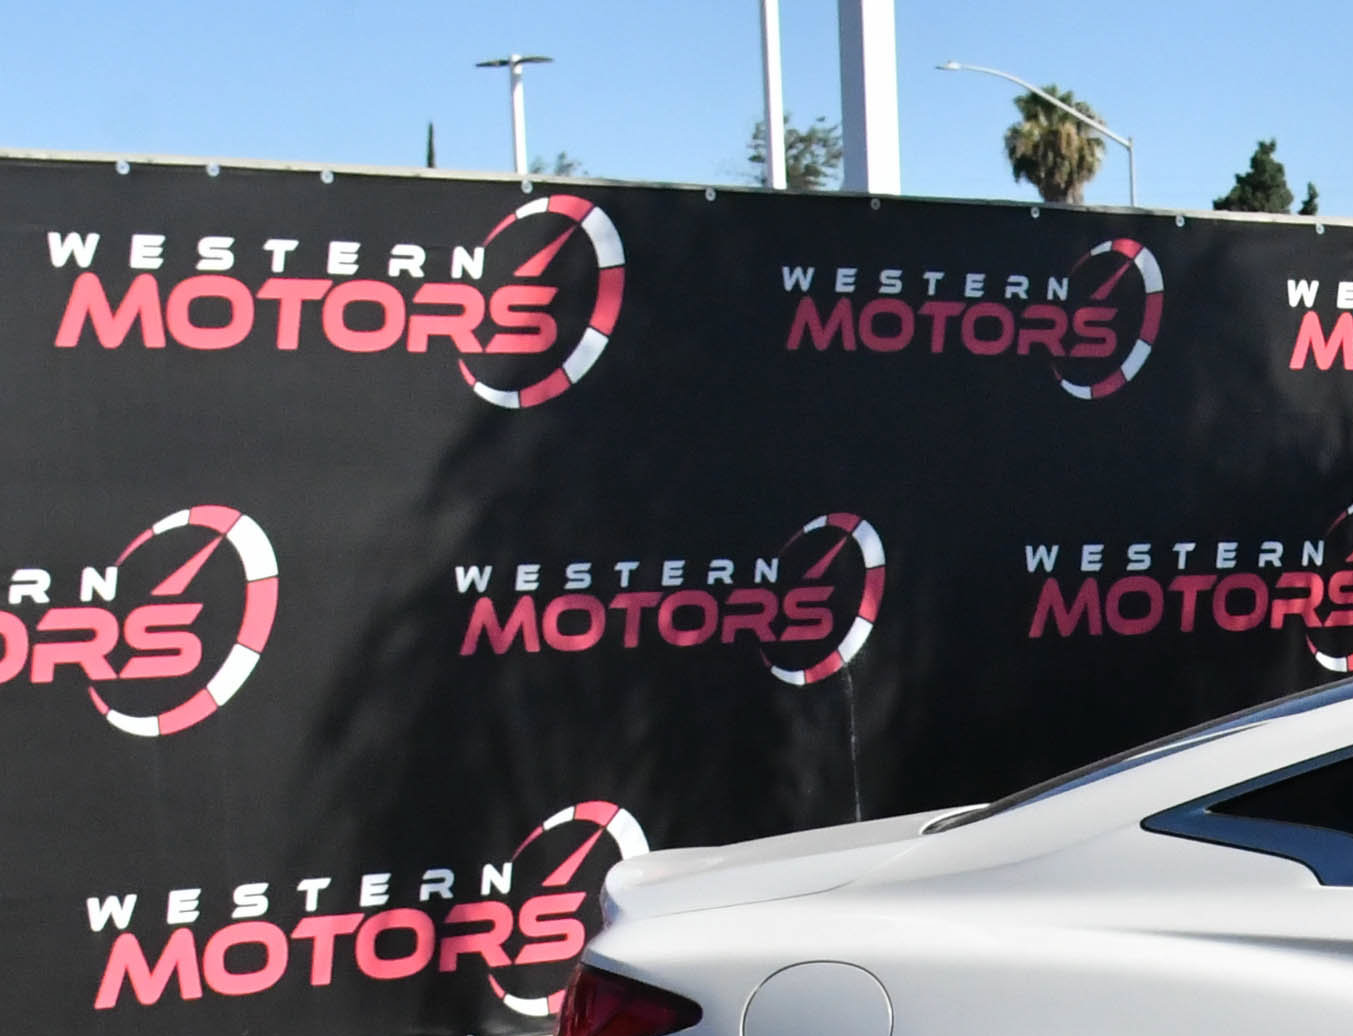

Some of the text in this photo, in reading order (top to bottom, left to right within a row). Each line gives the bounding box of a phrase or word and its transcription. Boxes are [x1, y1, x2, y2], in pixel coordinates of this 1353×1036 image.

[48, 231, 485, 281] WESTERN
[782, 266, 1070, 300] WESTERN
[54, 272, 559, 355] MOTORS
[786, 296, 1118, 358] MOTORS
[455, 557, 780, 593] WESTERN
[1025, 540, 1326, 572] WESTERN
[459, 586, 834, 656] MOTORS
[86, 862, 513, 933] WESTERN
[93, 891, 588, 1011] MOTORS
